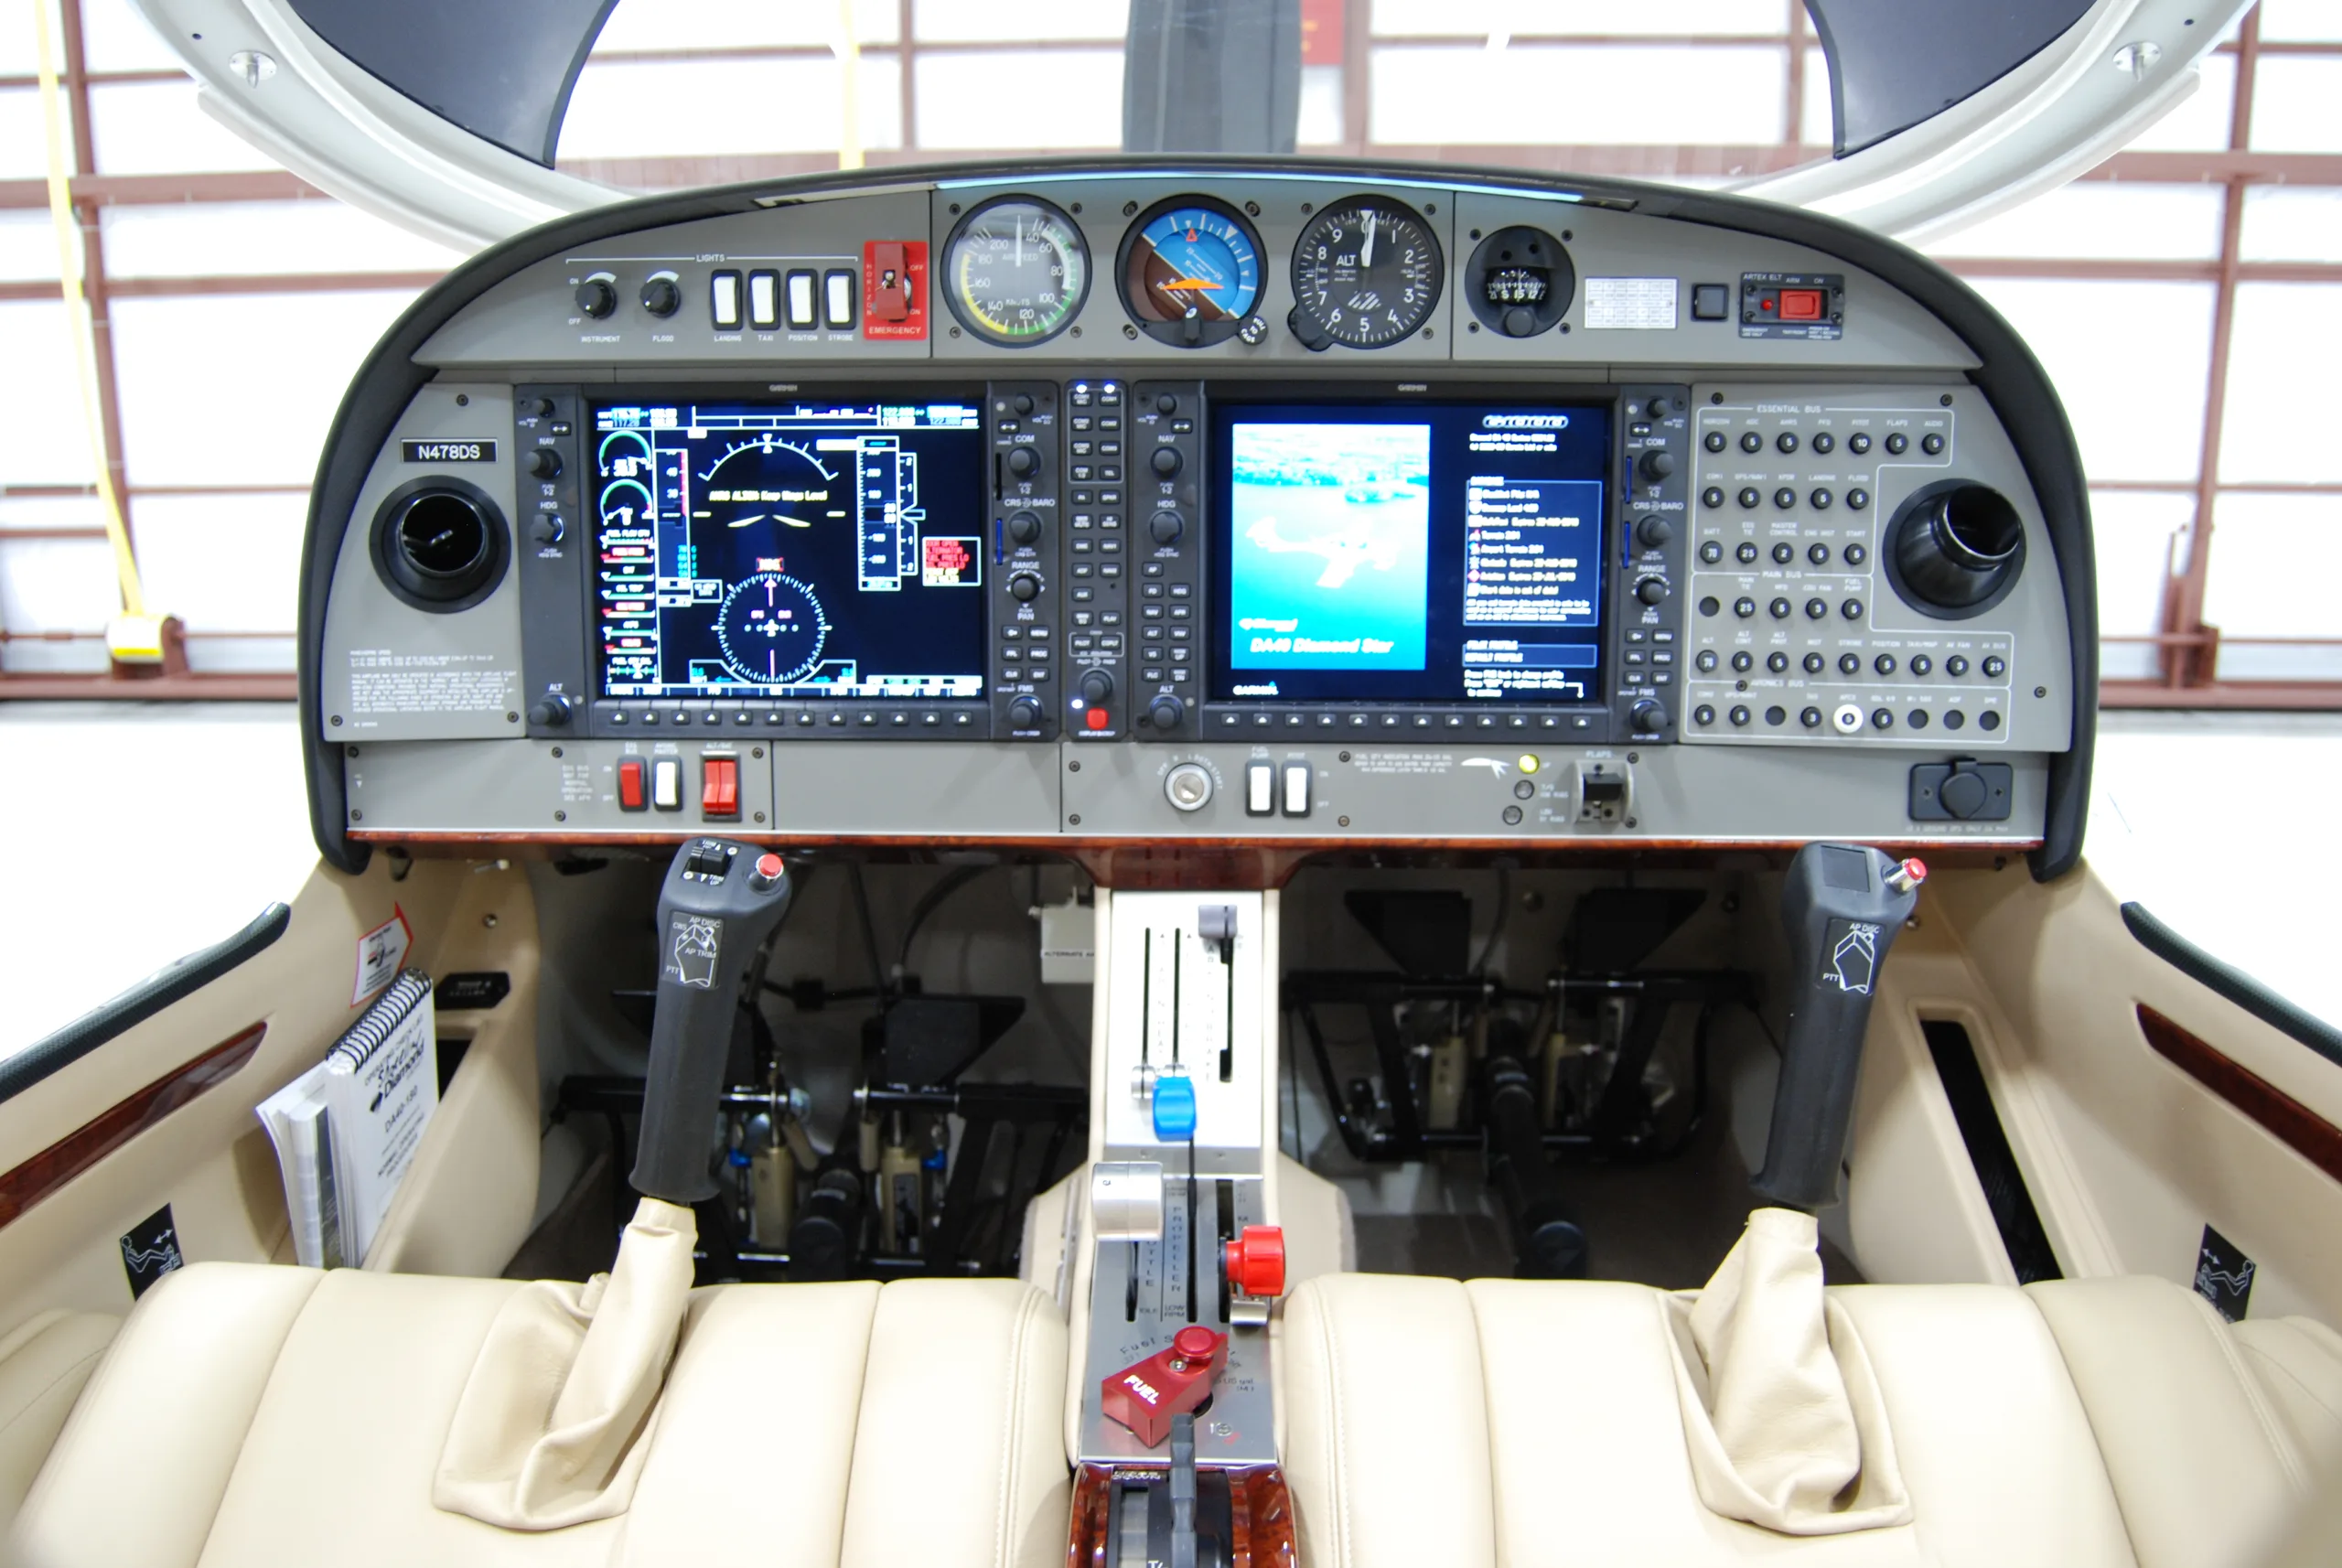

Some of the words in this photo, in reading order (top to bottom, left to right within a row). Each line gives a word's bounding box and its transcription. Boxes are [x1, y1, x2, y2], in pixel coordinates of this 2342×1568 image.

[1026, 233, 1039, 243] 40
[1332, 230, 1342, 243] 9
[990, 240, 1008, 250] 200
[1039, 243, 1052, 252] 60
[1318, 247, 1326, 260] 8
[1405, 250, 1414, 263] 2
[978, 254, 992, 264] 180
[1336, 255, 1356, 266] ALT
[1051, 266, 1063, 275] 80
[975, 278, 990, 288] 160
[1039, 293, 1055, 303] 100
[1319, 291, 1327, 305] 7
[1404, 290, 1414, 303] 3
[988, 301, 1003, 311] 140
[1019, 309, 1034, 319] 120
[1331, 308, 1342, 322] 6
[1387, 309, 1398, 322] 4
[1253, 317, 1266, 331] PULL
[1360, 318, 1370, 332] 5
[1250, 326, 1258, 334] TO
[1757, 405, 1800, 413] ESSENTIAL
[1804, 405, 1821, 413] BUS
[1015, 435, 1035, 443] COM
[1646, 438, 1665, 446] COM
[1714, 437, 1720, 446] 3
[1750, 438, 1756, 446] 5
[1786, 438, 1793, 446] 5
[1822, 438, 1829, 447] 5
[1857, 439, 1868, 447] 10
[1896, 439, 1902, 447] 5
[1933, 439, 1939, 448] 5
[418, 445, 480, 460] N478DS
[1711, 494, 1718, 502] 5
[1747, 494, 1754, 502] 5
[1784, 494, 1790, 503] 5
[1821, 494, 1827, 503] 5
[1856, 494, 1863, 503] 5
[1004, 499, 1021, 507] CRS
[1032, 499, 1055, 507] BARO
[1660, 502, 1684, 510] BARO
[1742, 549, 1754, 558] 25
[1781, 549, 1788, 558] 2
[1817, 550, 1824, 558] 5
[1854, 550, 1860, 558] 5
[1638, 564, 1666, 573] RANGE
[1740, 604, 1752, 612] 25
[1778, 604, 1785, 612] 5
[1815, 604, 1821, 613] 3
[1851, 605, 1858, 614] 5
[1641, 616, 1659, 624] PAN
[1250, 638, 1292, 653] DA40
[1292, 638, 1361, 653] Diamond
[1361, 638, 1394, 653] Star
[1740, 658, 1746, 666] 5
[1776, 658, 1783, 666] 5
[1812, 659, 1819, 667] 3
[1848, 660, 1855, 668] 5
[1885, 661, 1891, 670] 5
[1956, 662, 1963, 671] 3
[1990, 663, 2003, 671] 25
[1703, 712, 1709, 720] 5
[1739, 712, 1745, 720] 5
[1810, 714, 1816, 722] 3
[1586, 751, 1611, 759] FLAPS
[673, 922, 687, 931] CWS
[689, 916, 700, 924] AP
[701, 918, 720, 929] DISC
[1849, 923, 1861, 931] AP
[1862, 924, 1880, 934] DISC
[685, 947, 696, 956] AP
[698, 949, 717, 959] TRIM
[666, 965, 679, 974] PTT
[1823, 972, 1839, 983] PTT
[1172, 1207, 1182, 1292] PROPELLER
[1119, 1337, 1156, 1354] Fuel
[1123, 1375, 1160, 1405] FUEL
